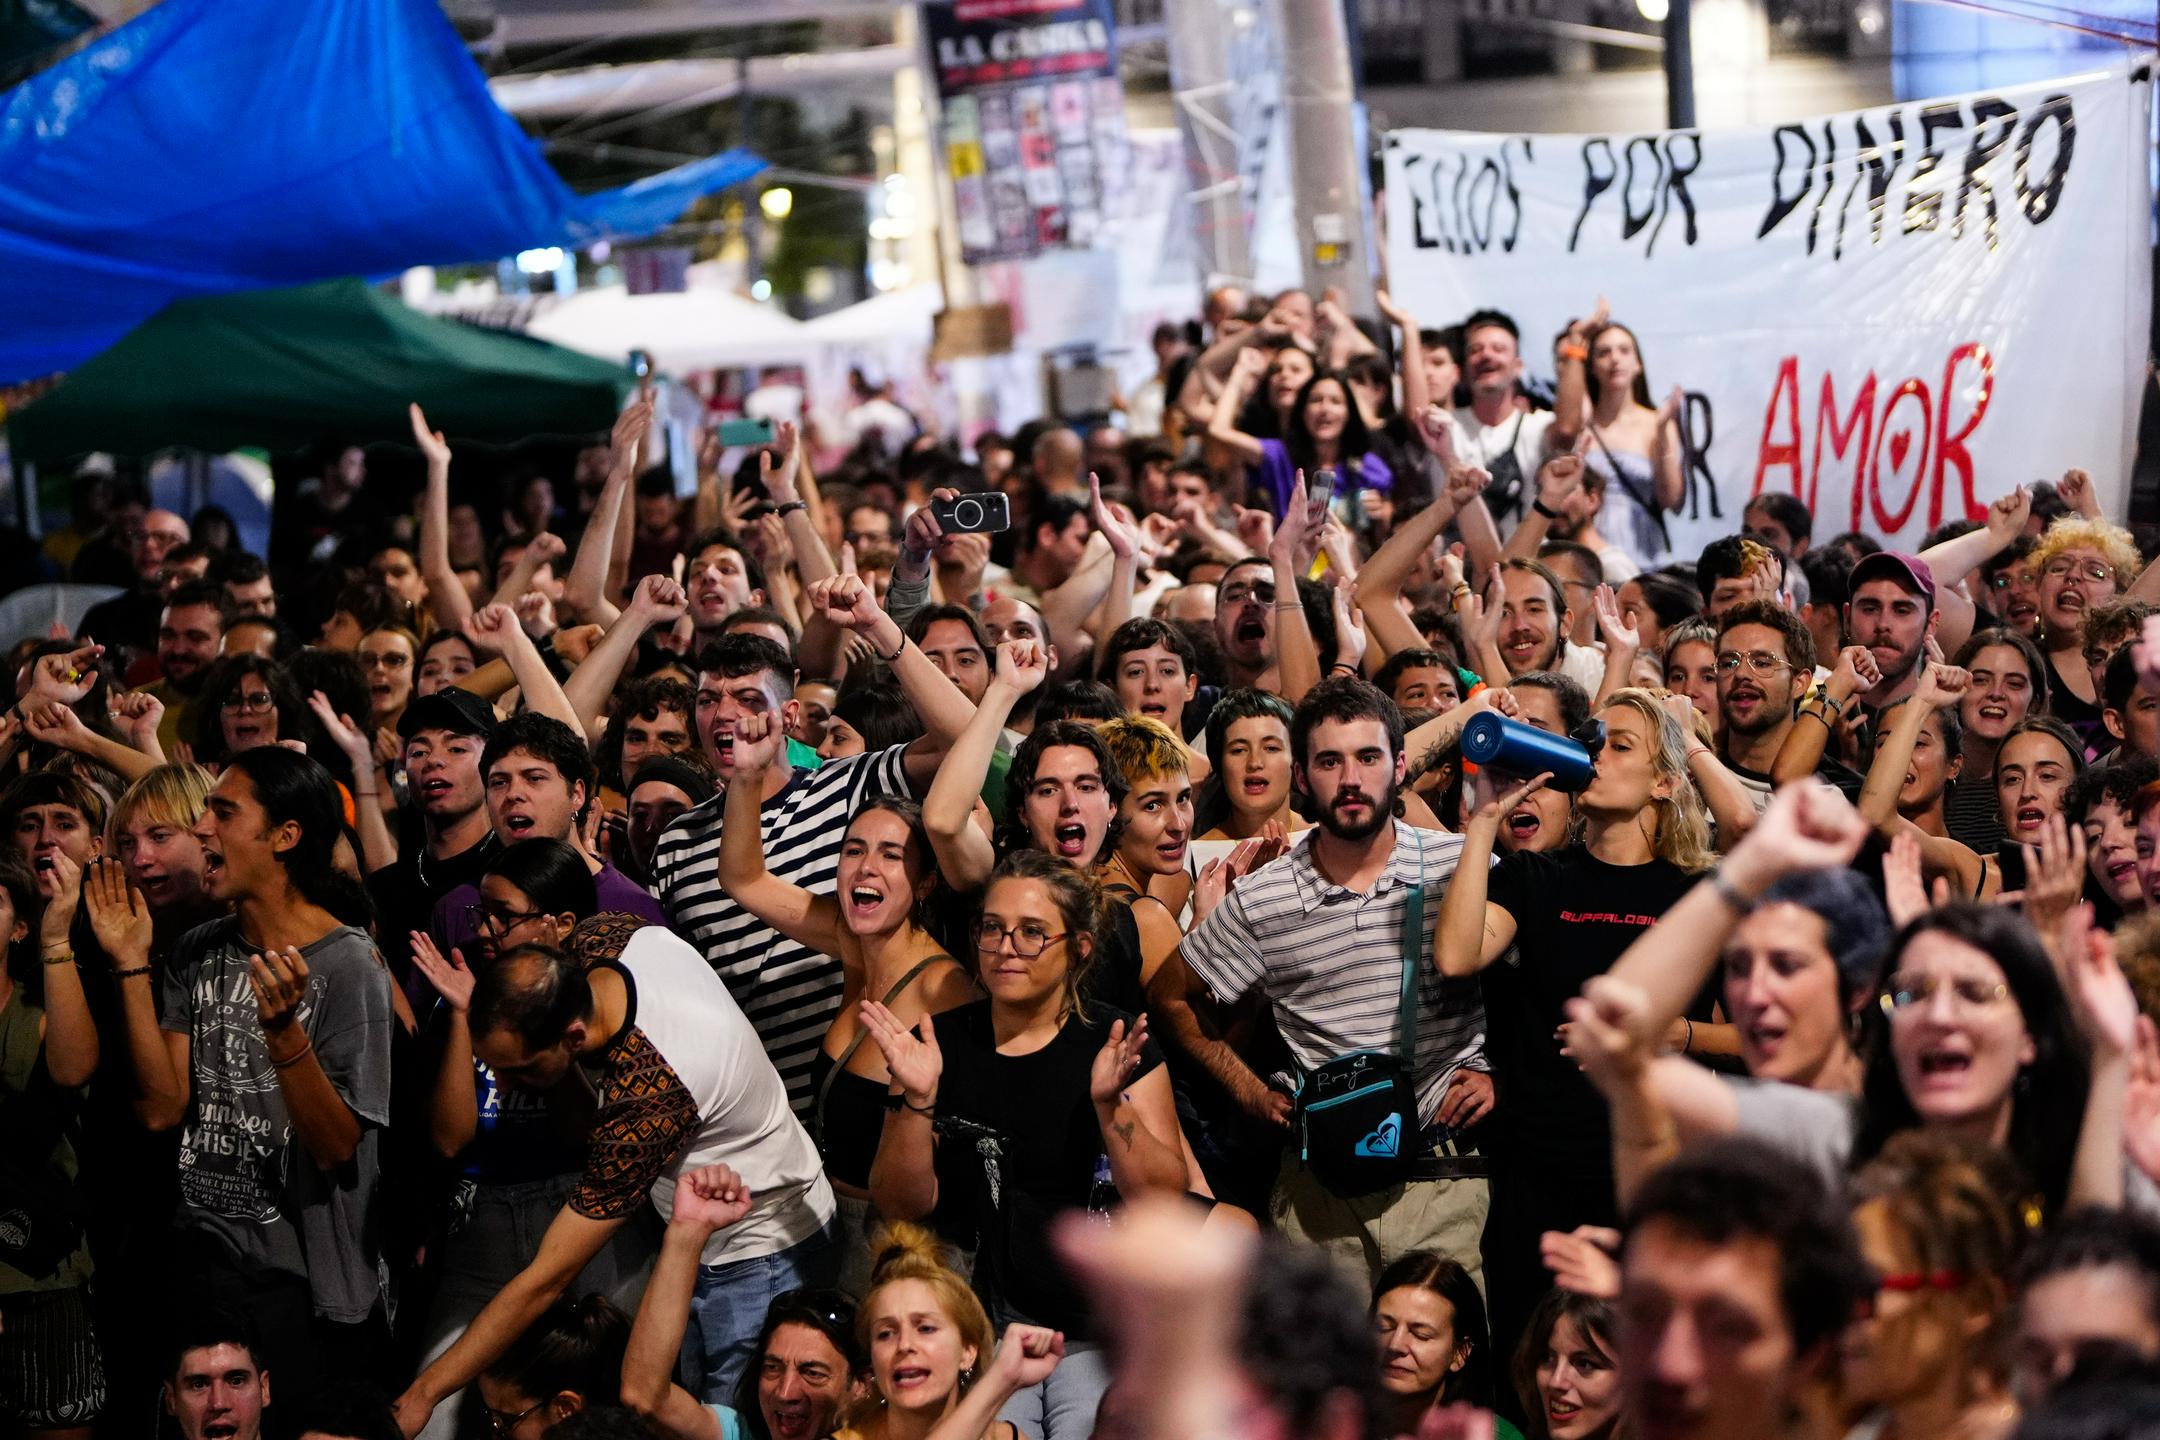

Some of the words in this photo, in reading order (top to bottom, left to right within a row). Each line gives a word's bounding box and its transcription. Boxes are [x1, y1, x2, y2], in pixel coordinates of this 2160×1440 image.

[1567, 135, 1700, 257] POR
[1757, 94, 2075, 260] DINERO
[1753, 341, 1992, 534] AMOR
